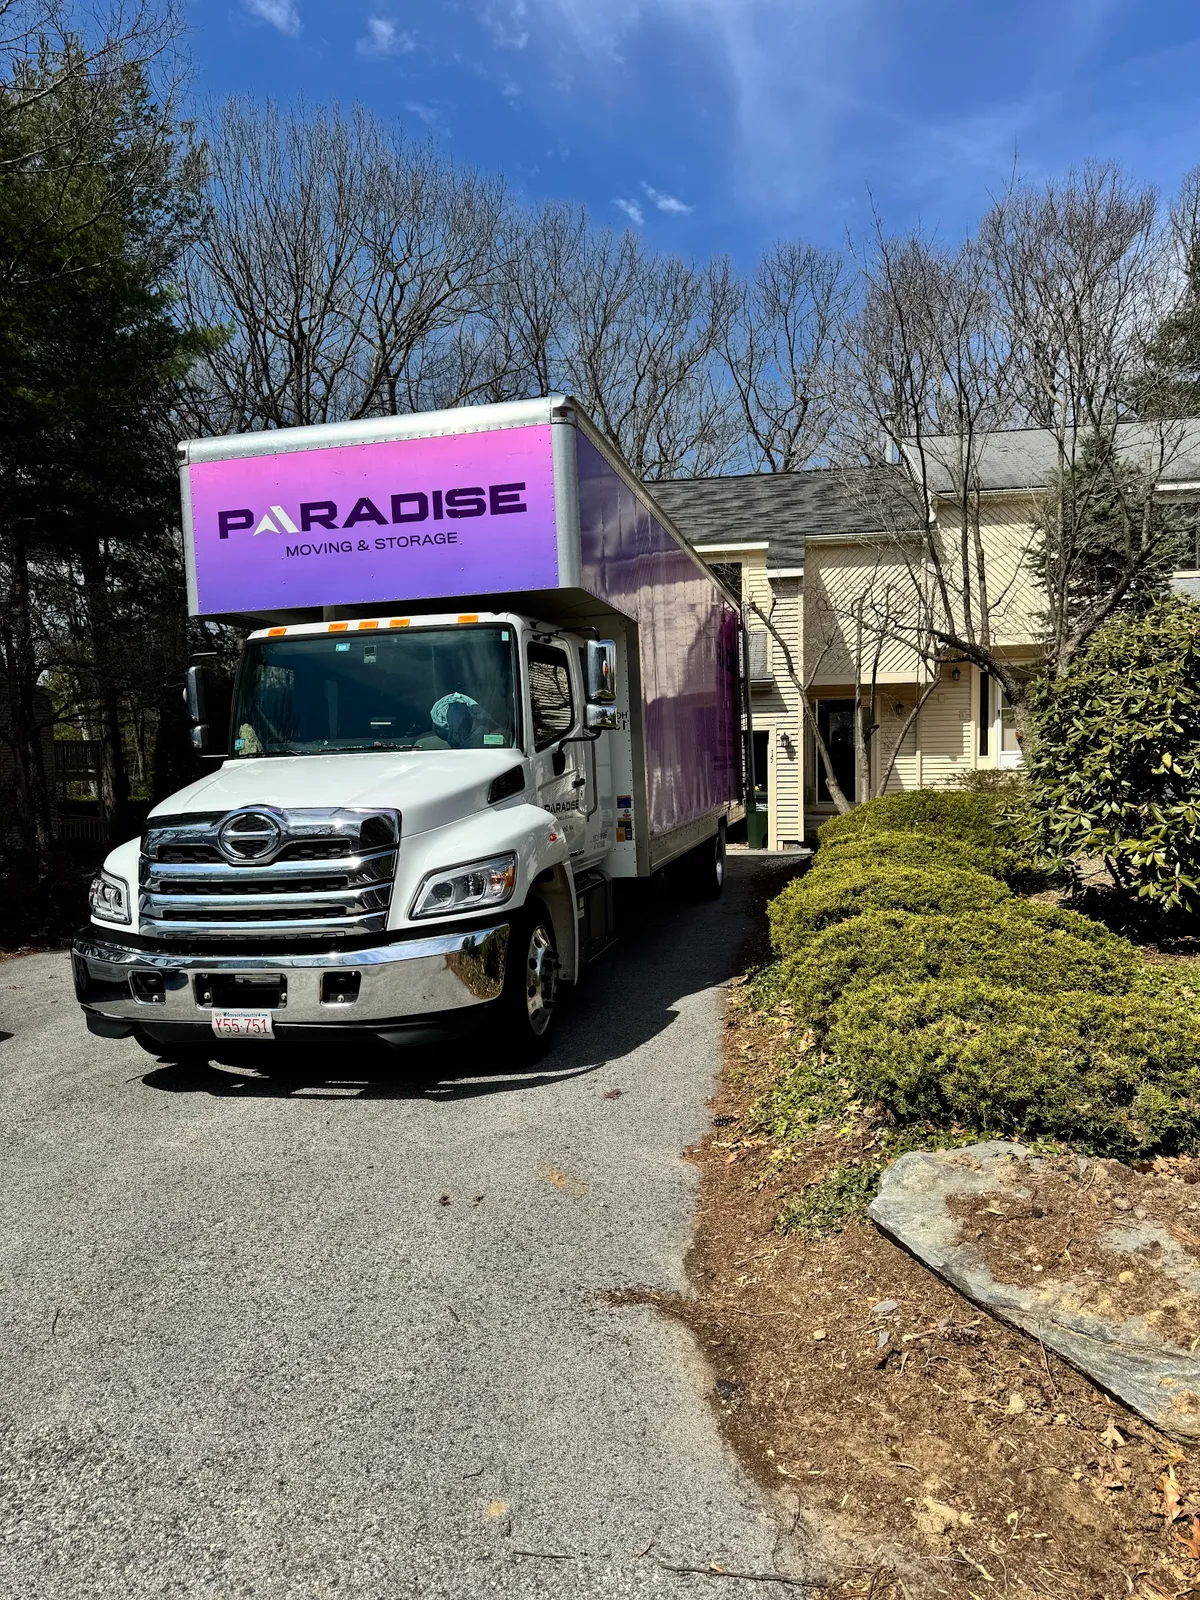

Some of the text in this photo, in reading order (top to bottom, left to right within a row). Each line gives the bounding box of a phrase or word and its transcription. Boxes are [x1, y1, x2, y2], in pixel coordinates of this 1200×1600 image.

[217, 482, 527, 540] PARADISE
[286, 532, 458, 557] MOVING & STORAGE
